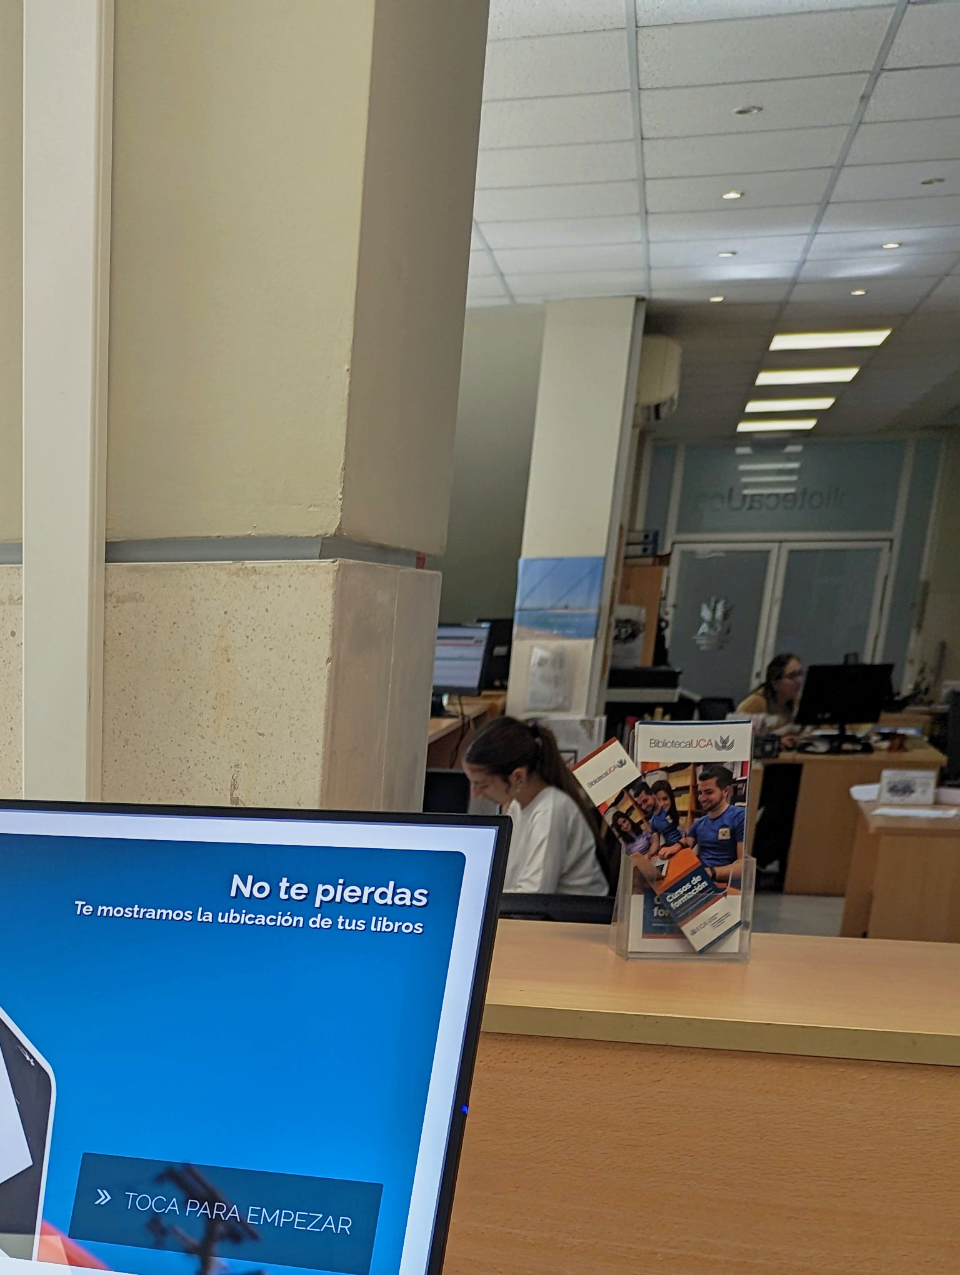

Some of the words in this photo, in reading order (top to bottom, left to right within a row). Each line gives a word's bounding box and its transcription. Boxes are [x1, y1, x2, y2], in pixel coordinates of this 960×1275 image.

[649, 737, 714, 749] BibliotecaUCA
[229, 873, 271, 898] No
[278, 876, 309, 900] te
[315, 878, 429, 908] pierdas
[666, 882, 692, 903] Cursos
[691, 874, 703, 885] de
[670, 881, 709, 910] formación
[74, 901, 94, 916] Te
[97, 904, 193, 922] mostramos
[197, 907, 214, 923] la
[217, 909, 305, 928] ubicación
[308, 913, 333, 930] de
[337, 915, 366, 932] tus
[370, 916, 424, 935] libros
[125, 1191, 179, 1215] TOCA
[186, 1199, 241, 1222] PARA
[246, 1206, 352, 1235] EMPEZAR
